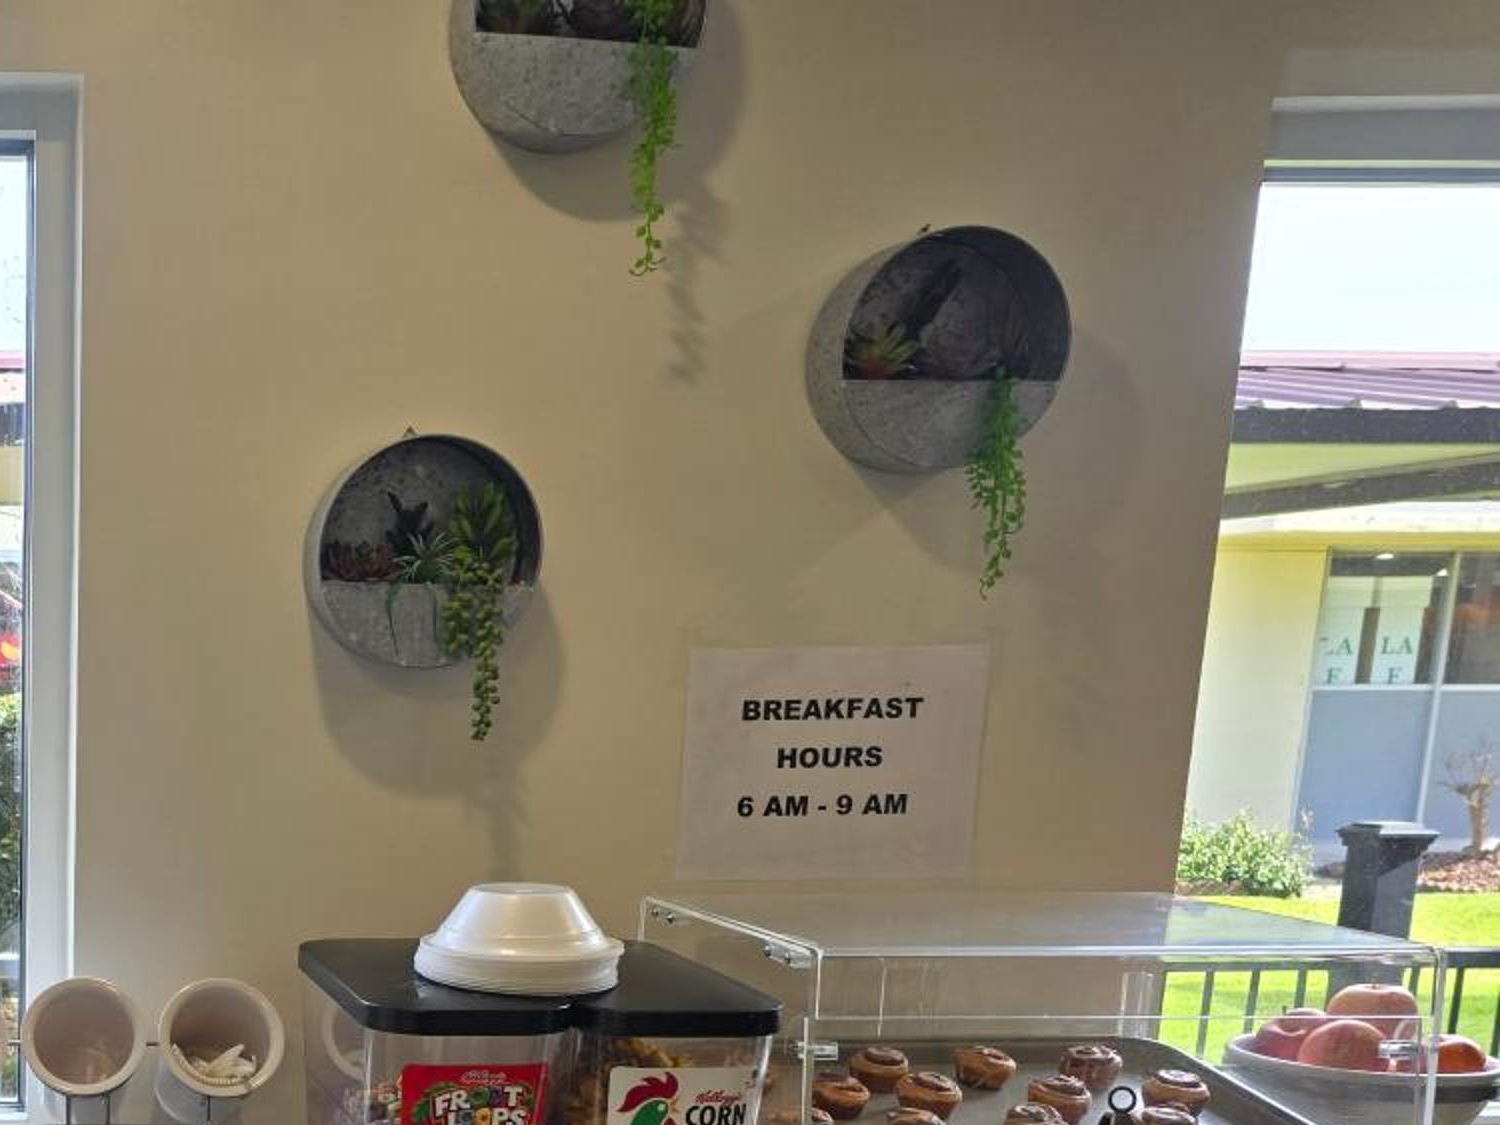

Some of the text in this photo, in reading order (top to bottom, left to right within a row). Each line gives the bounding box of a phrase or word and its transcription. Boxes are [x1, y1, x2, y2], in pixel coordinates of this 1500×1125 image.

[741, 698, 924, 720] BREAKFAST
[777, 747, 883, 768] HOURS
[737, 797, 754, 817] 6
[763, 796, 809, 816] AM
[836, 795, 853, 815] 9
[862, 794, 908, 815] AM
[435, 1086, 523, 1118] FROOT
